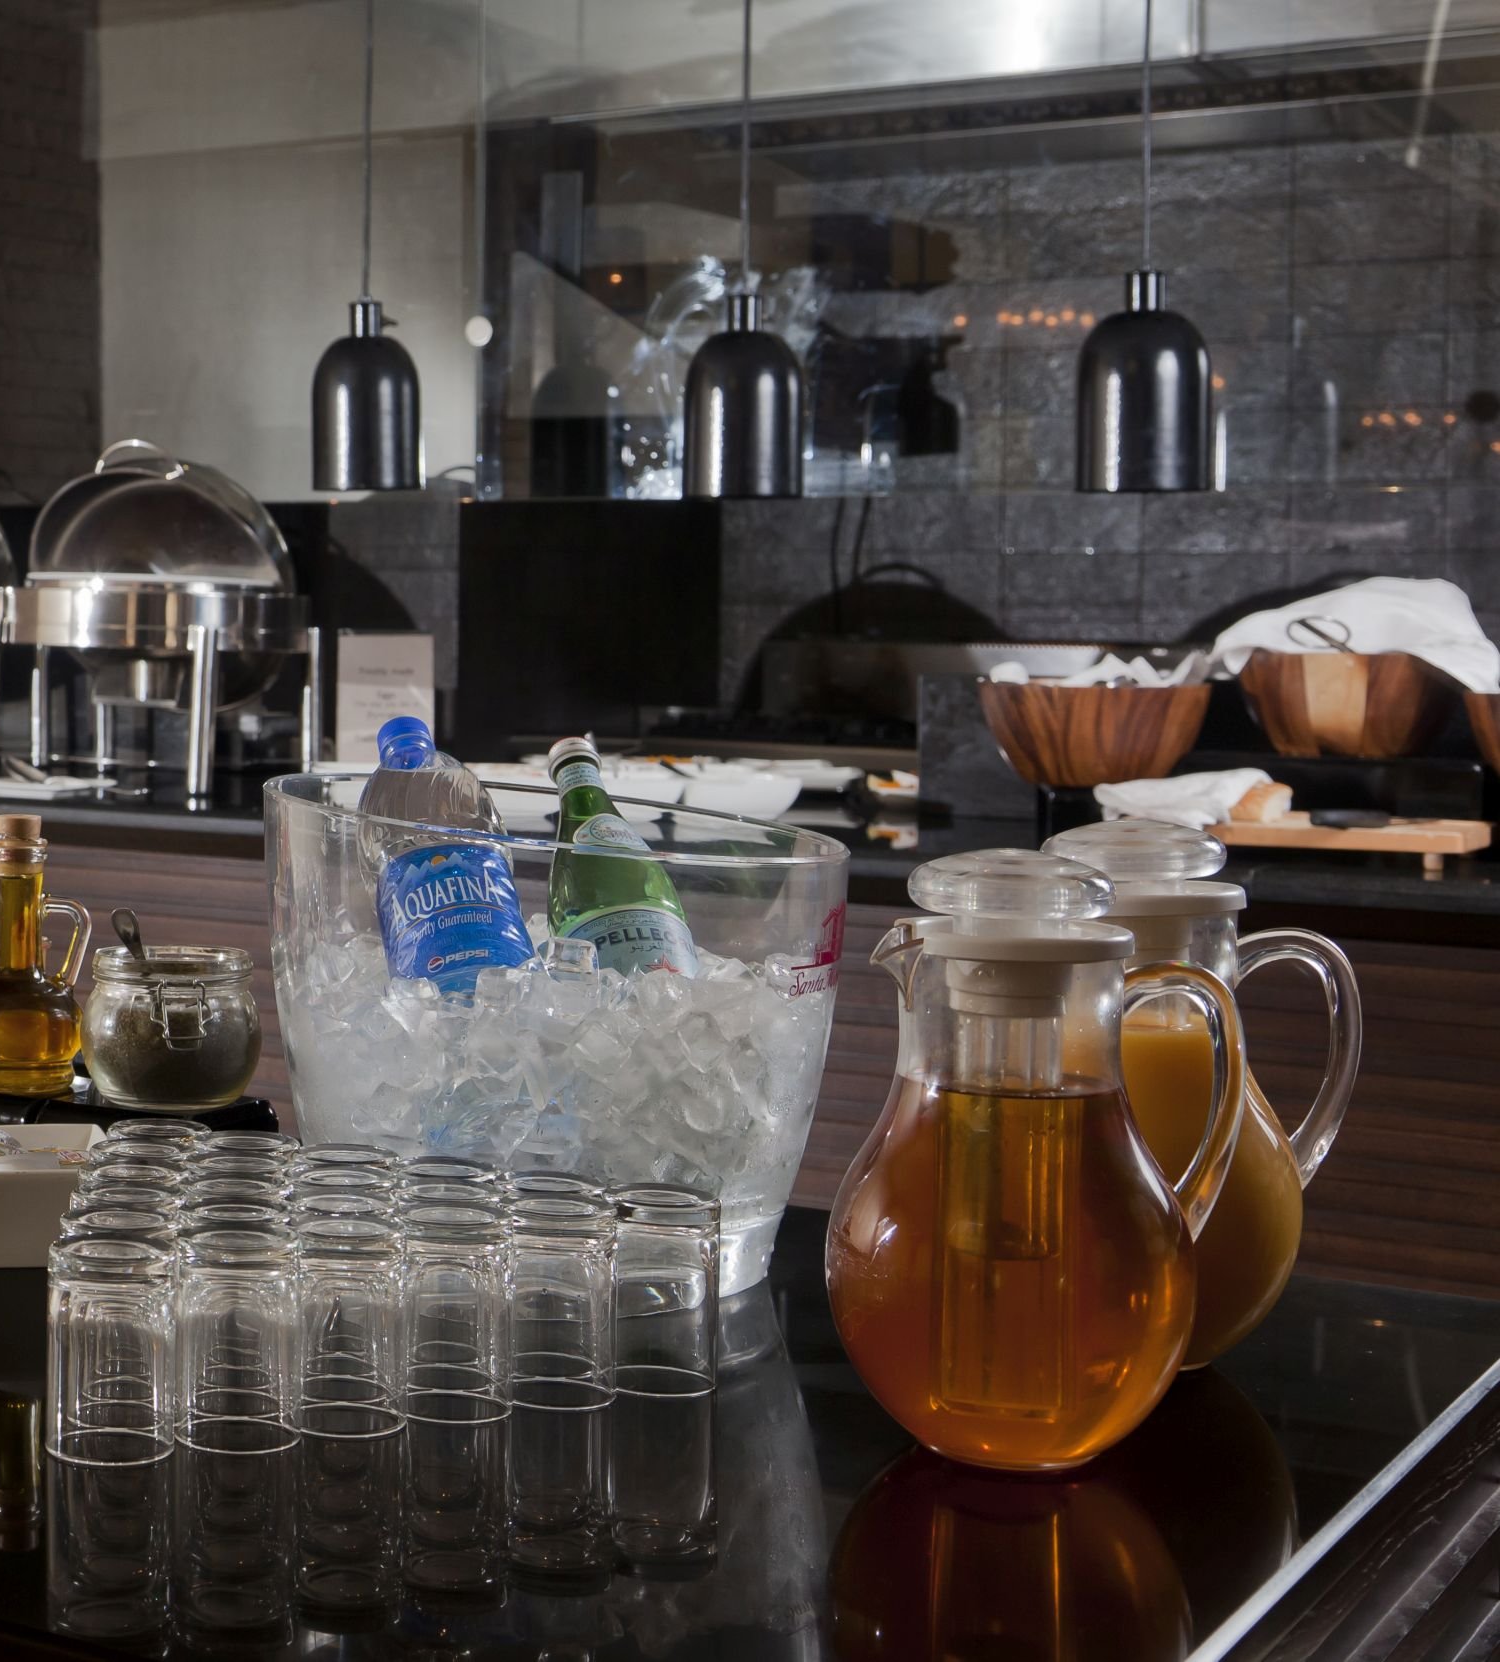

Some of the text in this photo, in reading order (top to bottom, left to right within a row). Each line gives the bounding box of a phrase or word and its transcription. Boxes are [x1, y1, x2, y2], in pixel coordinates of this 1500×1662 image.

[391, 867, 506, 935] AQUAFINA
[438, 911, 492, 929] Guaranteed
[445, 949, 489, 964] PEPSI
[789, 972, 823, 996] Santa
